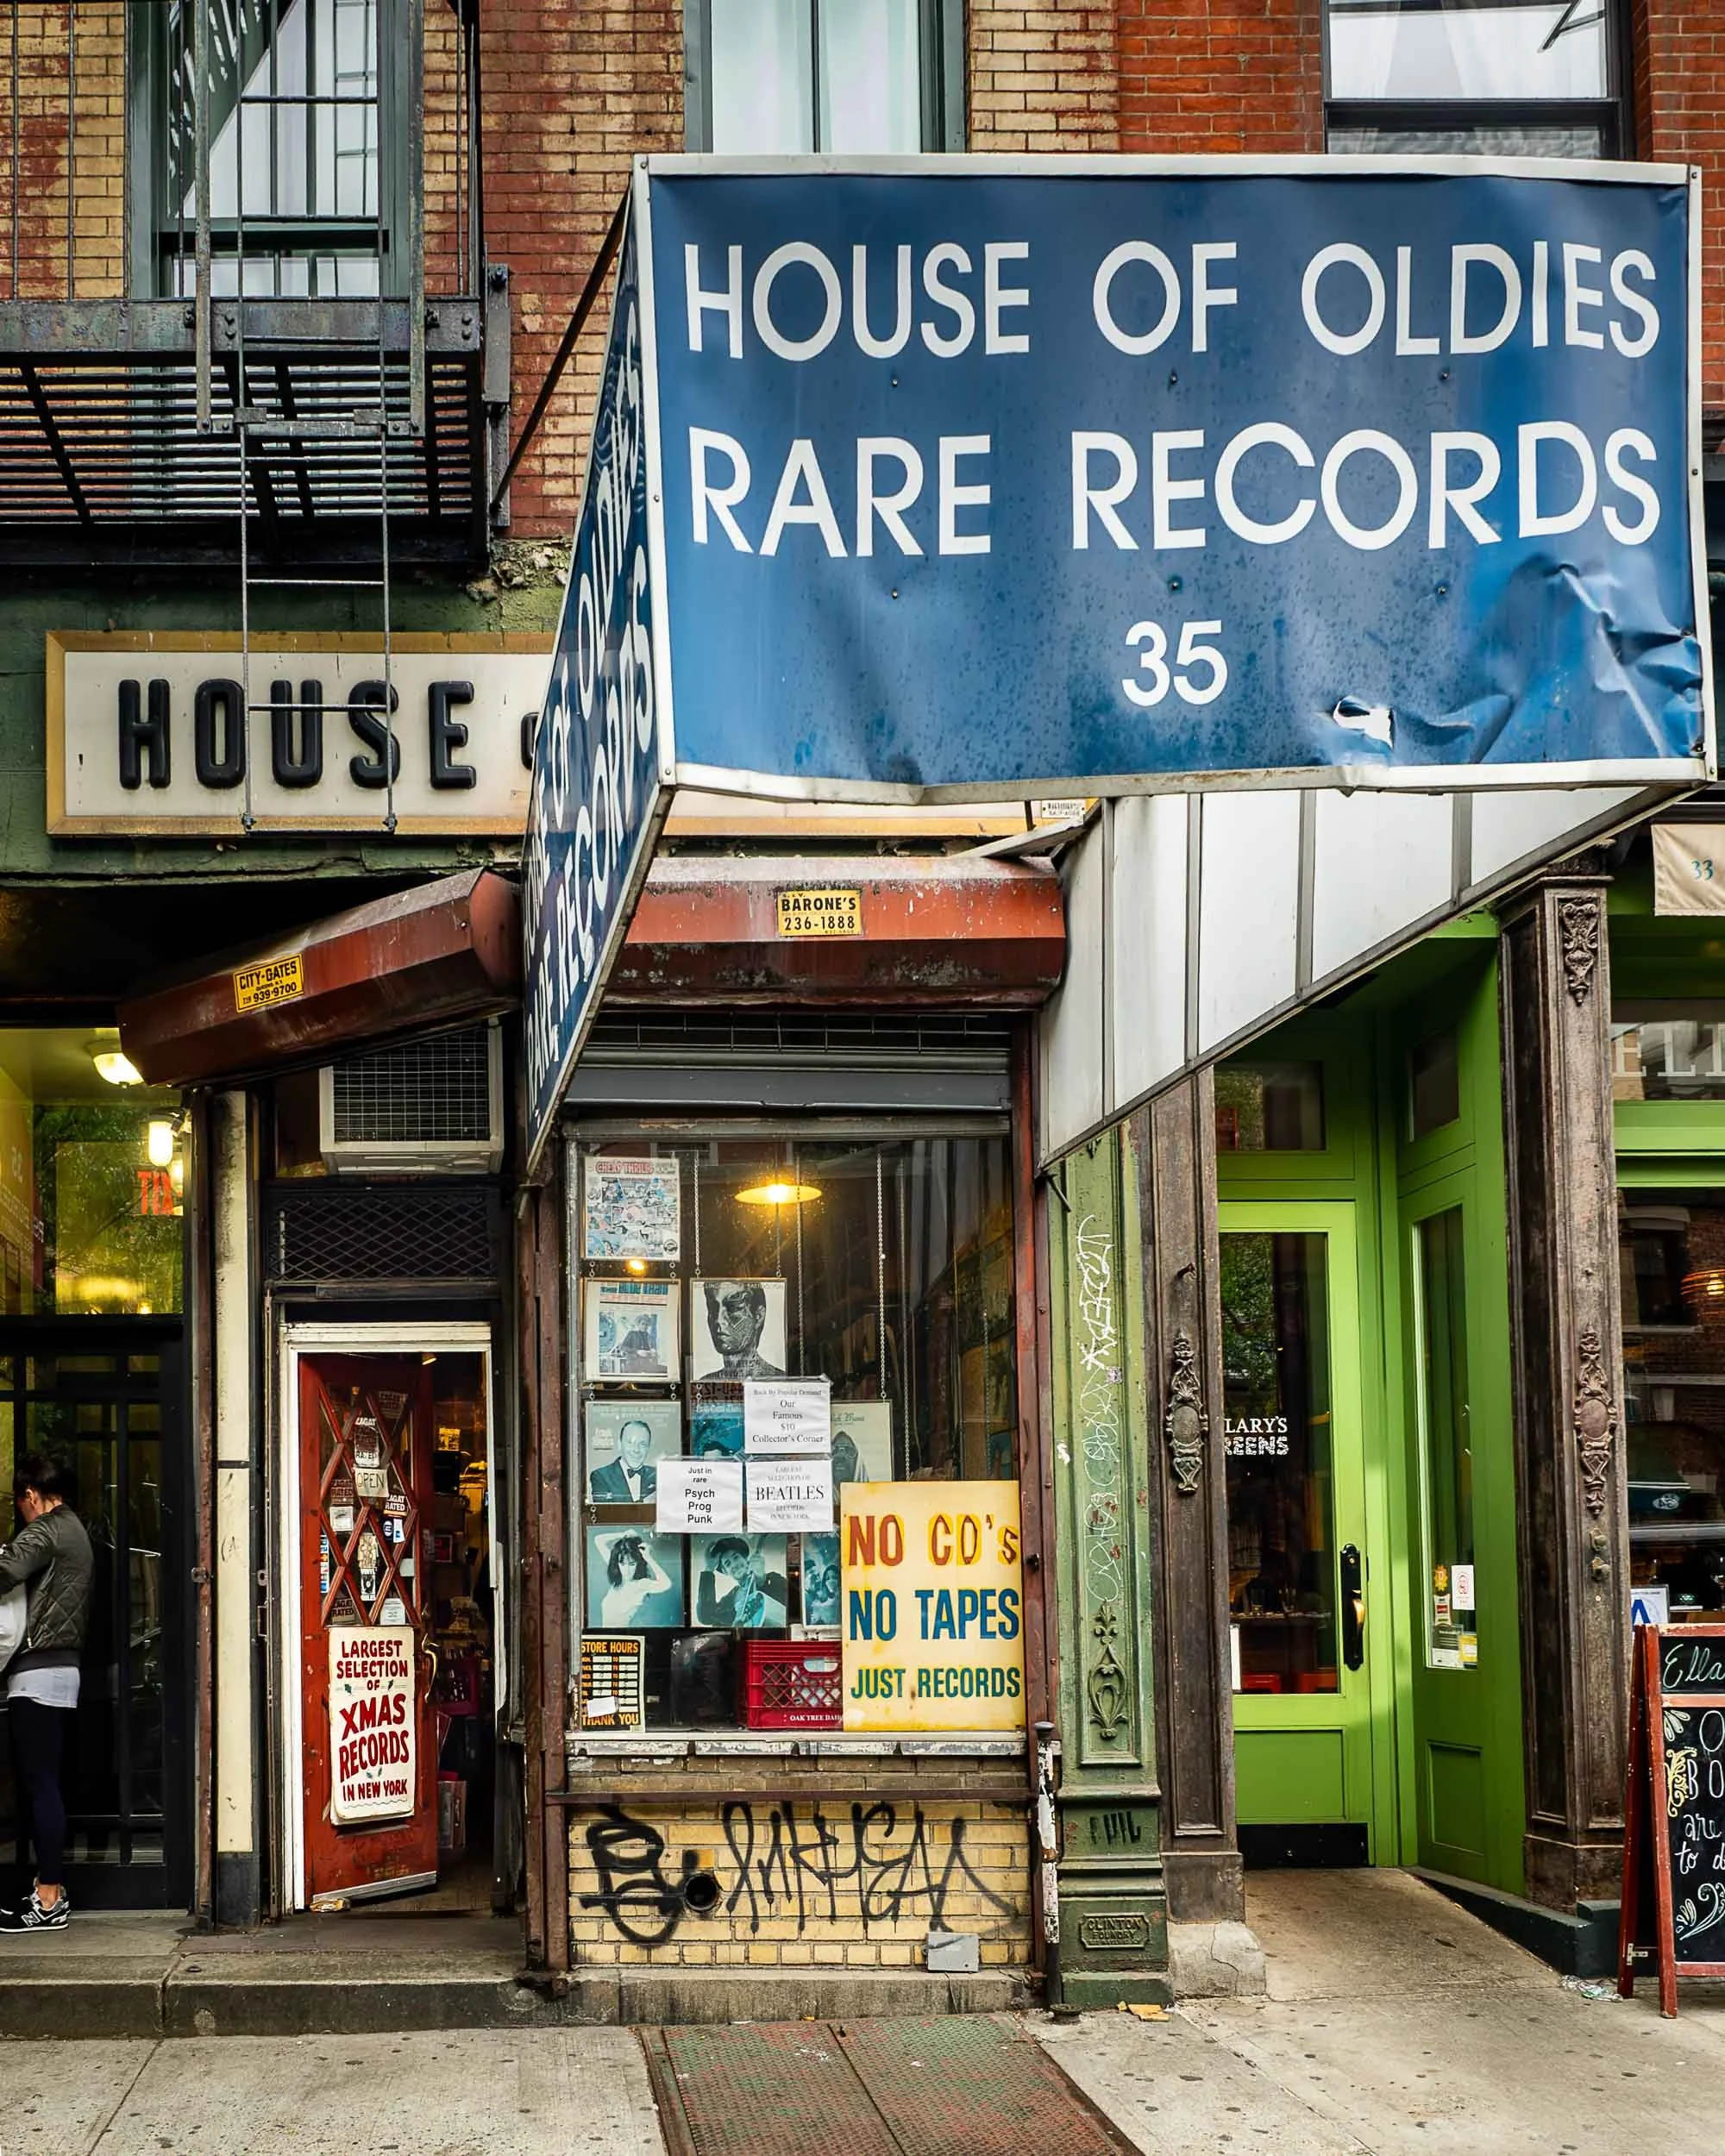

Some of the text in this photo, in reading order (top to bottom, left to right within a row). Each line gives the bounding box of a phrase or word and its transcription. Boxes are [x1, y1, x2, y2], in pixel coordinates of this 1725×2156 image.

[686, 241, 1659, 360] HOUSE OF OLDIES
[690, 422, 1659, 557] RARE RECORDS
[579, 303, 639, 721] OLDIES
[1122, 621, 1227, 706] 35
[118, 679, 477, 789] HOUSE
[556, 546, 653, 1023] RECORDS
[1691, 859, 1713, 880] 33
[781, 897, 856, 912] BARONE'S
[785, 916, 855, 931] 236-1888
[239, 960, 298, 990] CITY-GATES
[780, 1400, 795, 1408] Our
[772, 1411, 803, 1420] Famous
[752, 1434, 824, 1443] Collector's Corner
[356, 1472, 385, 1489] OPEN
[685, 1489, 715, 1501] Psych
[756, 1485, 825, 1501] BEATLES
[688, 1501, 712, 1513] Prog
[687, 1514, 712, 1524] Punk
[849, 1514, 903, 1566] NO
[849, 1588, 1019, 1641] NO TAPES
[341, 1640, 403, 1658] LARGEST
[581, 1641, 638, 1653] STORE HOURS
[336, 1660, 408, 1679] SELECTION
[367, 1679, 380, 1691] OF
[850, 1667, 1020, 1699] JUST RECORDS
[339, 1693, 407, 1741] XMAS
[581, 1714, 639, 1726] THANK YOU
[338, 1730, 410, 1783] RECORDS
[342, 1778, 408, 1802] IN NEW YORK
[1683, 1813, 1722, 1841] are
[1674, 1840, 1699, 1874] to
[21, 1911, 41, 1927] N
[1087, 1918, 1141, 1931] CLINTON
